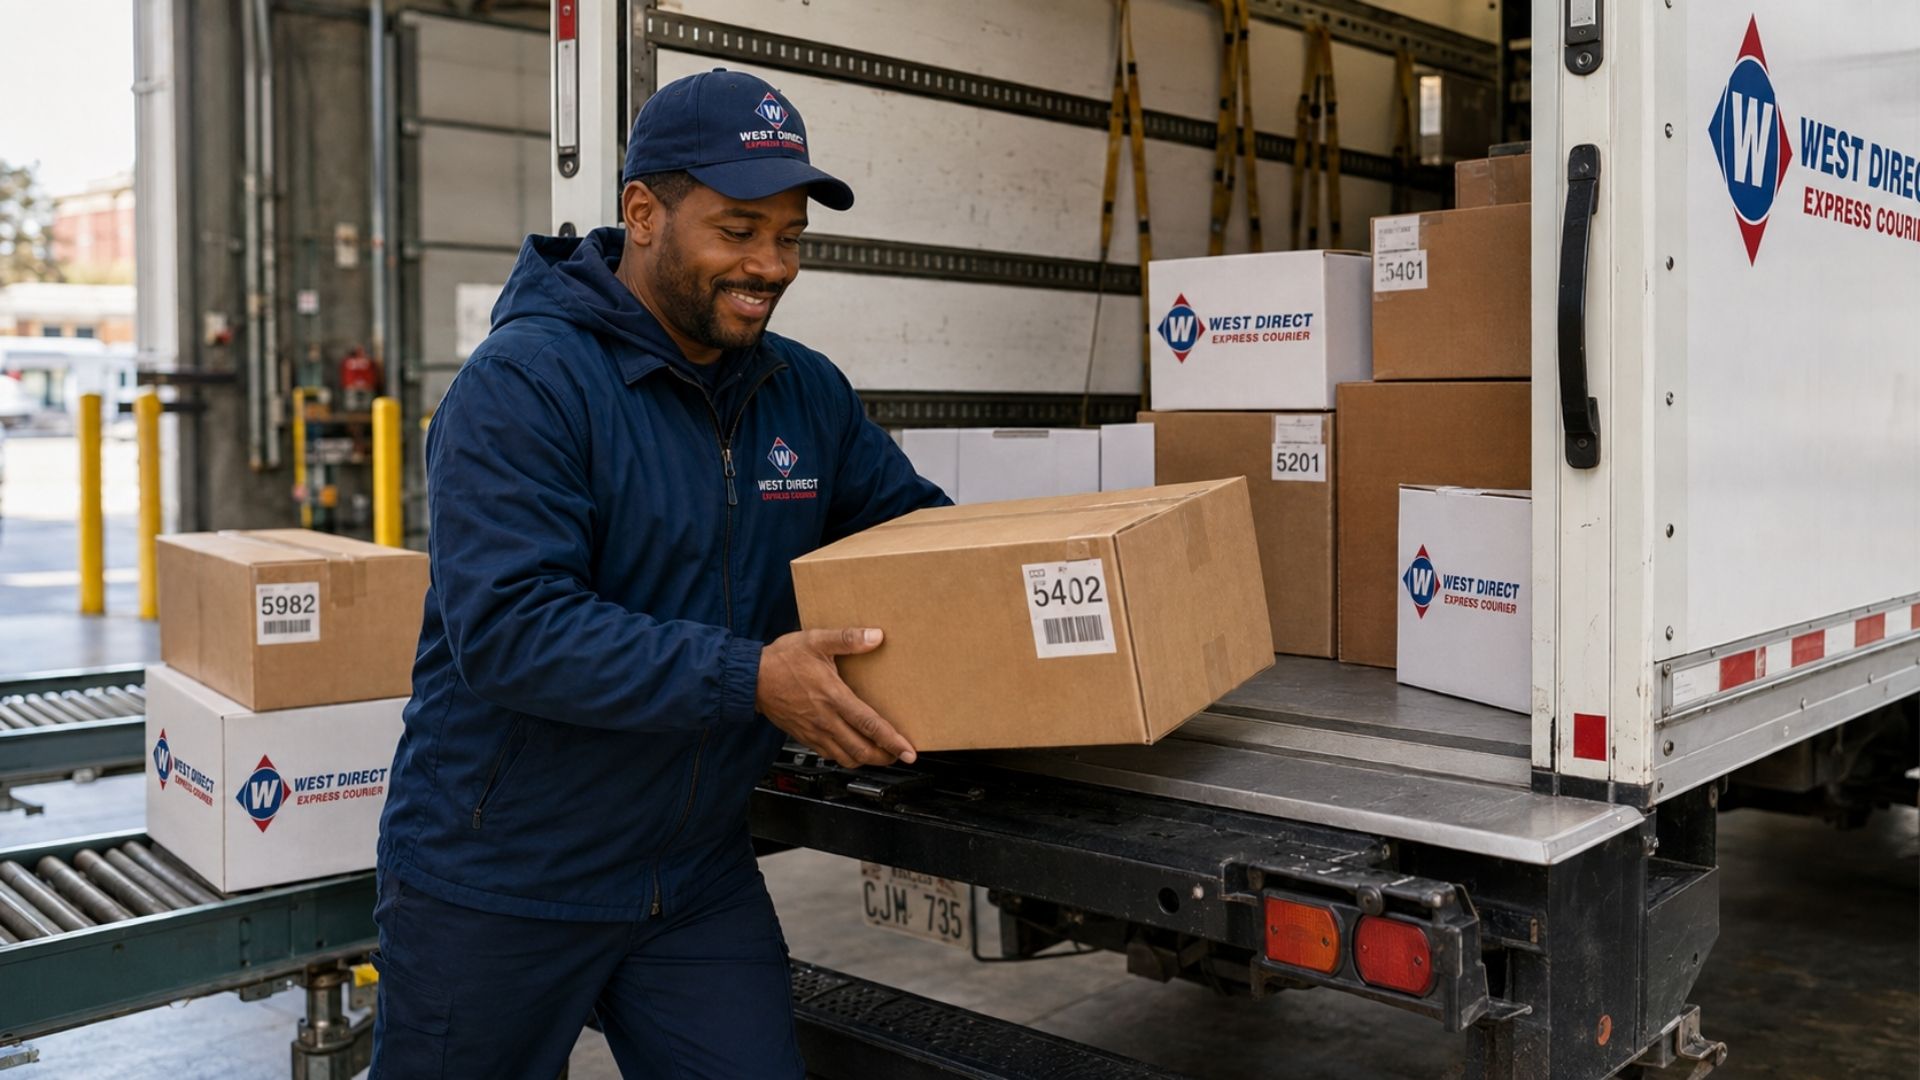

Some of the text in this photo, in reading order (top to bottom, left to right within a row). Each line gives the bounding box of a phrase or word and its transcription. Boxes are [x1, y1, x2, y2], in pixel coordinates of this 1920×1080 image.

[763, 105, 780, 120] W
[740, 130, 774, 141] WEST
[1732, 91, 1774, 188] W
[1801, 116, 1864, 182] WEST
[1803, 186, 1871, 230] EXPRESS
[1168, 315, 1194, 343] W
[1209, 313, 1313, 331] WEST DIRECT
[1212, 331, 1310, 344] EXPRESS COURIER
[774, 450, 790, 467] W
[1276, 452, 1318, 473] 5201
[757, 478, 819, 491] WEST DIRECT
[1033, 576, 1103, 607] 5402
[1412, 567, 1433, 596] W
[1443, 574, 1520, 600] WEST DIRECT
[262, 594, 316, 616] 5982
[1444, 594, 1517, 614] EXPRESS COURIER
[157, 746, 169, 772] W
[294, 768, 388, 792] WEST DIRECT
[250, 779, 280, 809] W
[297, 786, 384, 805] EXPRESS COURIER
[923, 894, 962, 939] 735
